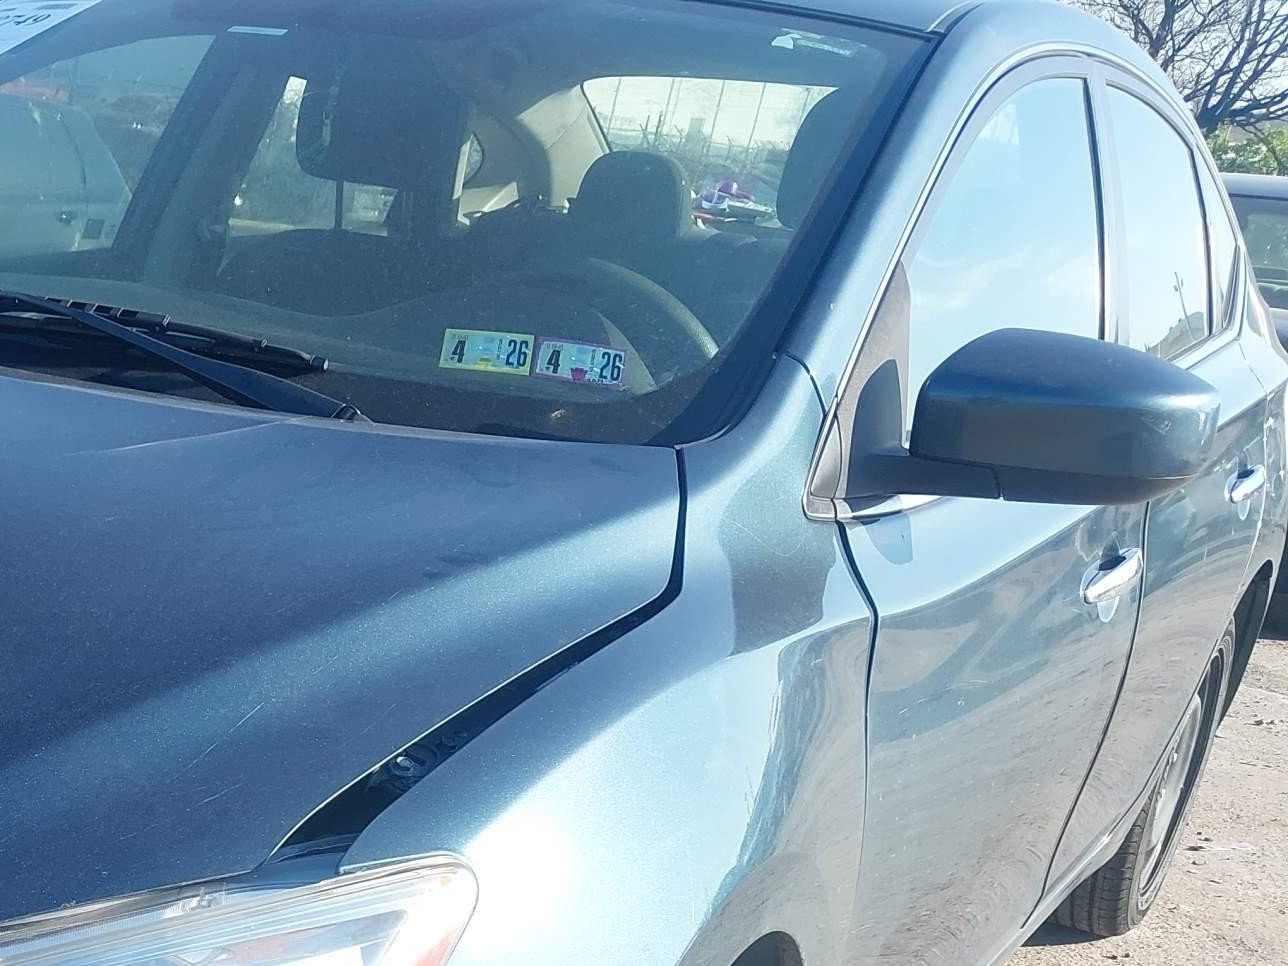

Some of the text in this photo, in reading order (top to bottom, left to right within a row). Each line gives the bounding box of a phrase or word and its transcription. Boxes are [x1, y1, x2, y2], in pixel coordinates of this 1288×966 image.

[451, 340, 467, 363] 4
[504, 339, 530, 368] 26
[546, 349, 561, 374] 4
[598, 351, 623, 381] 26
